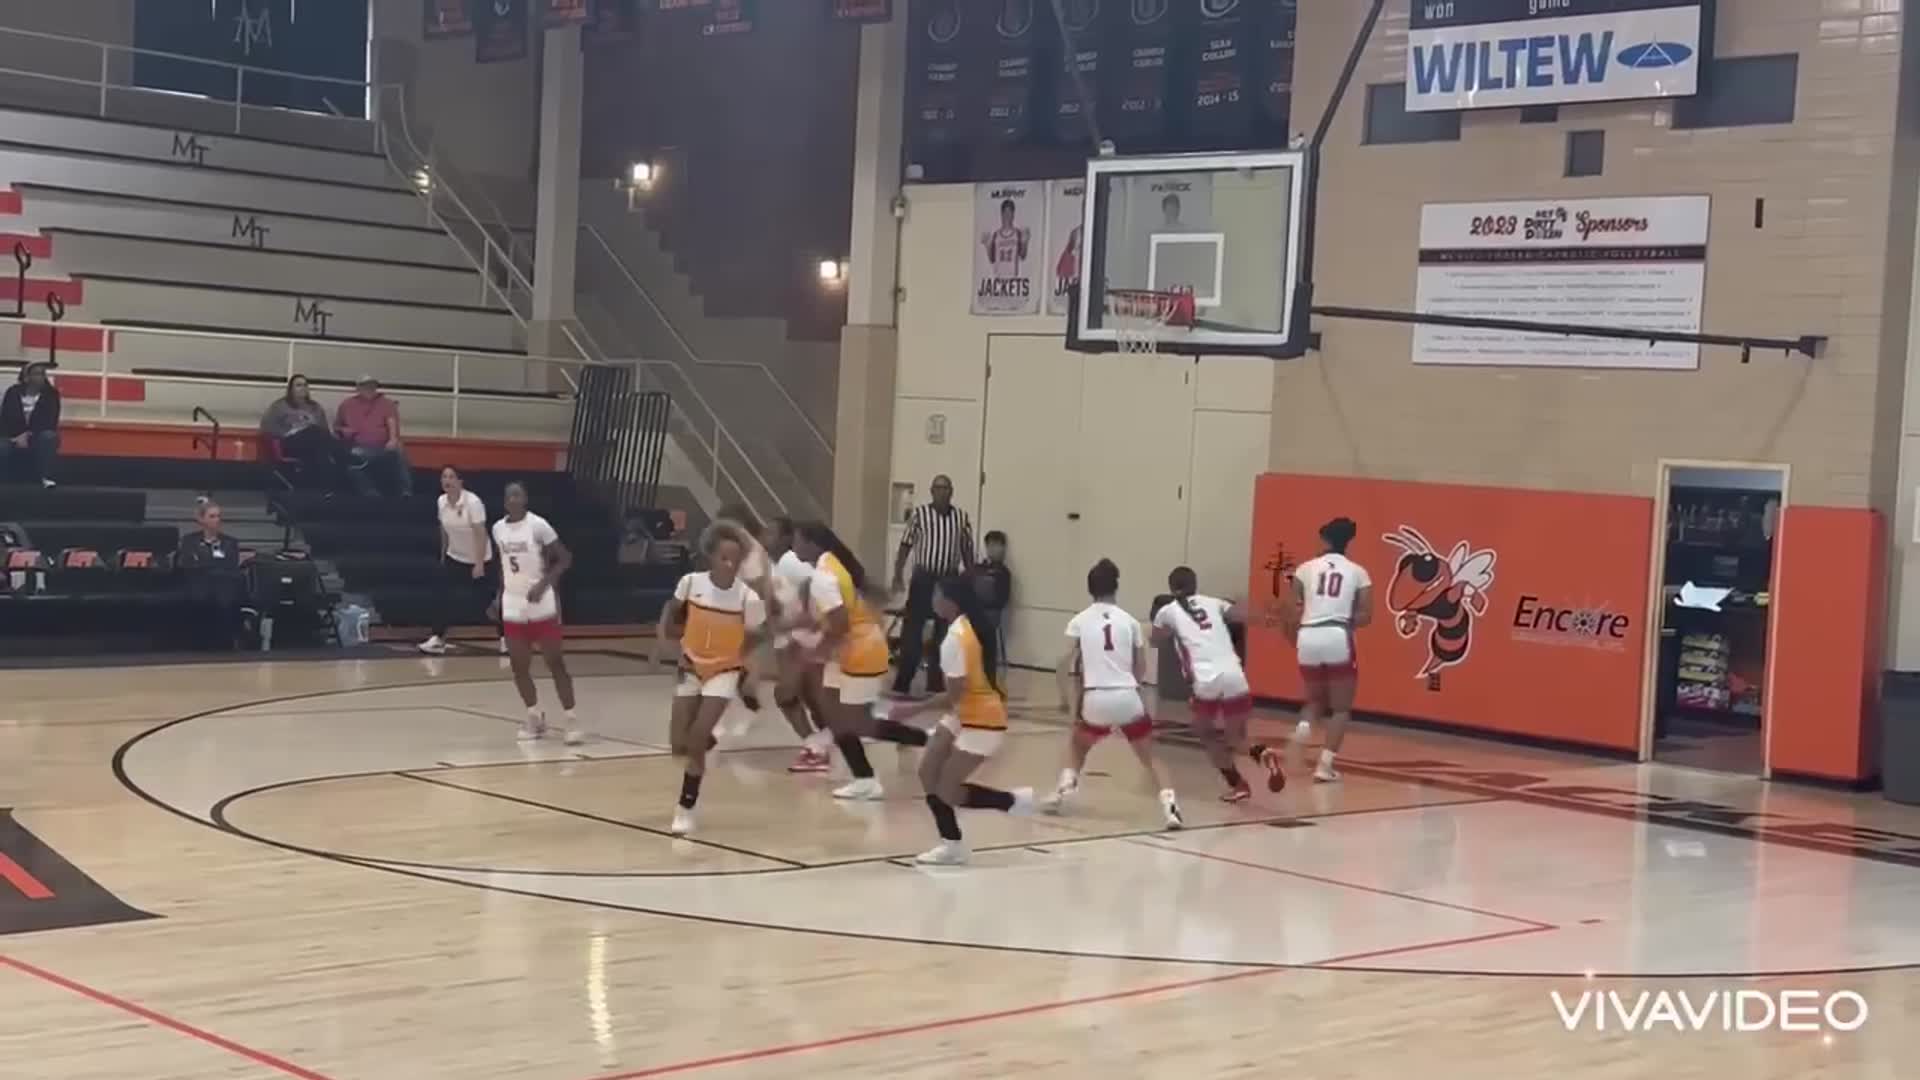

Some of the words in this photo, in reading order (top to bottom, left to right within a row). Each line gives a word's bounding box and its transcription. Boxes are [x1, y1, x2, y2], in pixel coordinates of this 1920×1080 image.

[1424, 3, 1455, 20] won
[1413, 31, 1614, 95] WILTEW
[172, 133, 212, 165] MT
[231, 214, 270, 248] MT
[1469, 214, 1518, 236] 2023
[1576, 210, 1649, 241] Sponsors
[977, 277, 1030, 297] JACKETS
[294, 298, 333, 337] MT
[509, 556, 520, 574] 5
[1316, 572, 1343, 598] 10
[1513, 595, 1630, 639] Encore
[1103, 624, 1115, 651] 1
